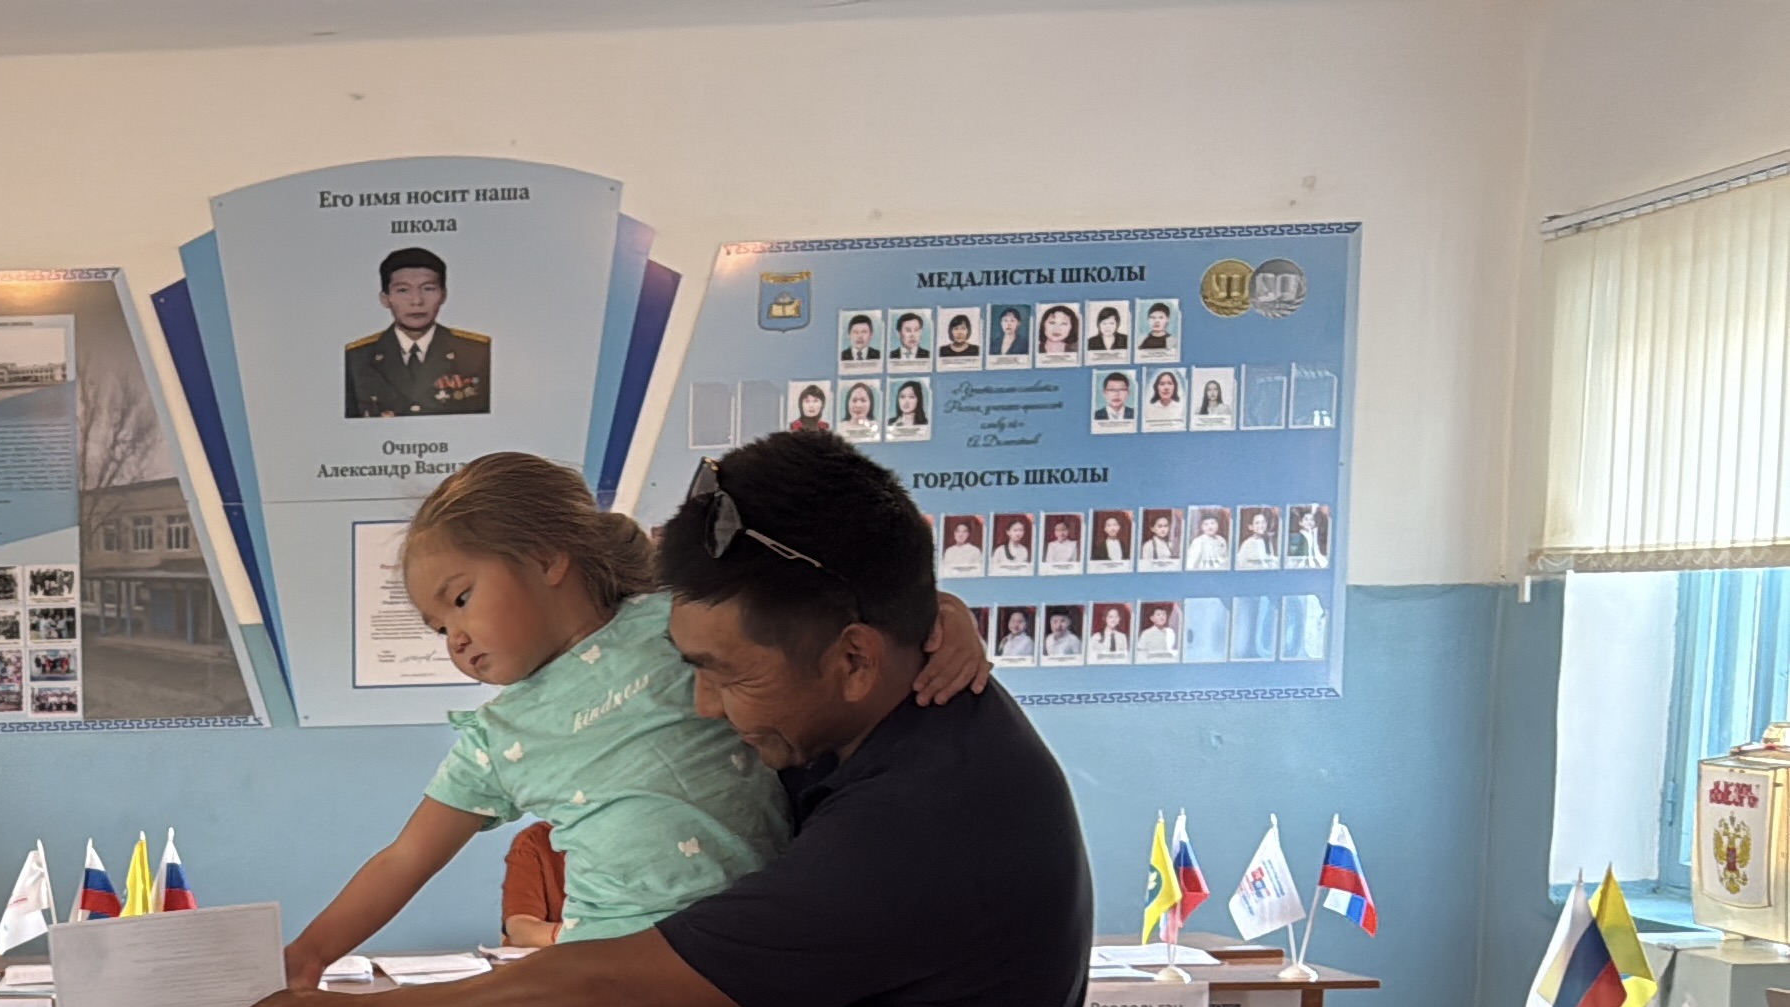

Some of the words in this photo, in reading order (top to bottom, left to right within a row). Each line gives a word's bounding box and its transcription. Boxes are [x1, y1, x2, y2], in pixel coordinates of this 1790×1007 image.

[319, 190, 353, 209] Его
[358, 191, 401, 206] имя
[405, 189, 470, 205] носит
[474, 186, 530, 202] наша
[390, 218, 458, 234] школа
[916, 267, 1056, 290] МЕДАЛИСТЫ
[1061, 265, 1146, 284] ШКОЛЫ
[381, 440, 449, 459] Очиров
[316, 463, 411, 480] Александр
[912, 468, 1019, 492] ГОРДОСТЬ
[1024, 466, 1110, 486] ШКОЛЫ
[572, 673, 650, 734] kindness
